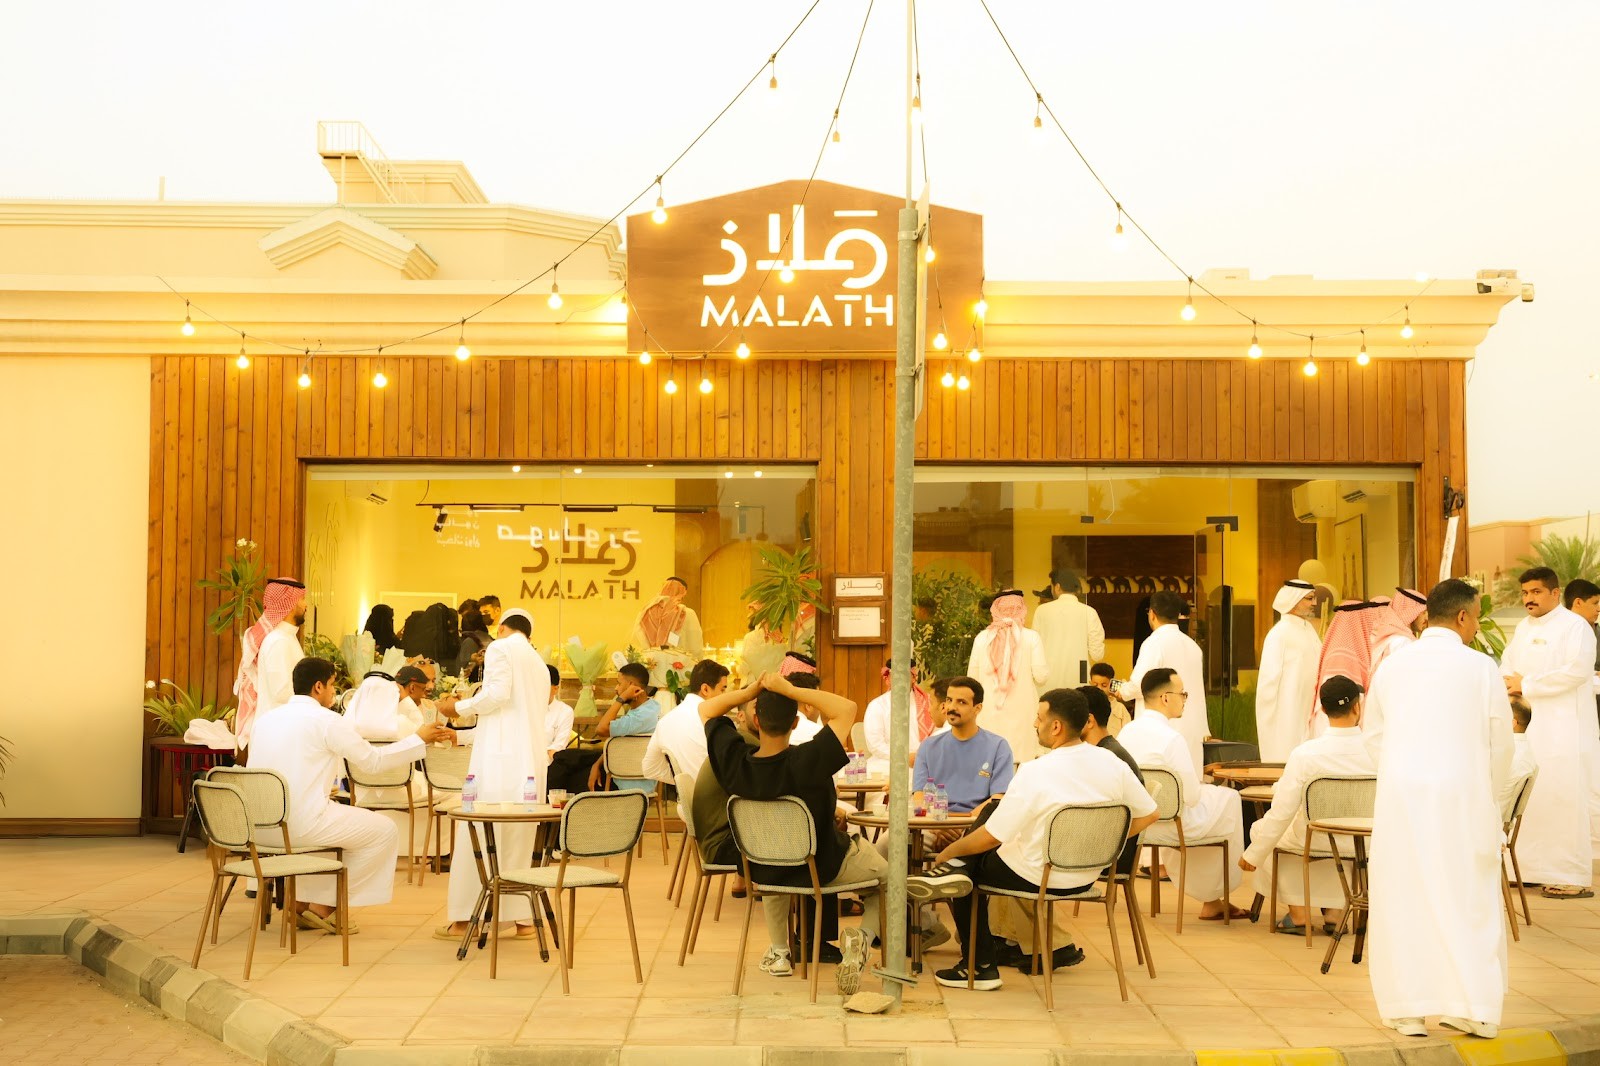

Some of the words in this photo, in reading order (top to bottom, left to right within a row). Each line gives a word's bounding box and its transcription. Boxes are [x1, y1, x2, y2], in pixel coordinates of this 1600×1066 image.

[703, 204, 888, 289] ملاذ
[701, 294, 894, 327] MALATH
[520, 579, 640, 600] MALATH
